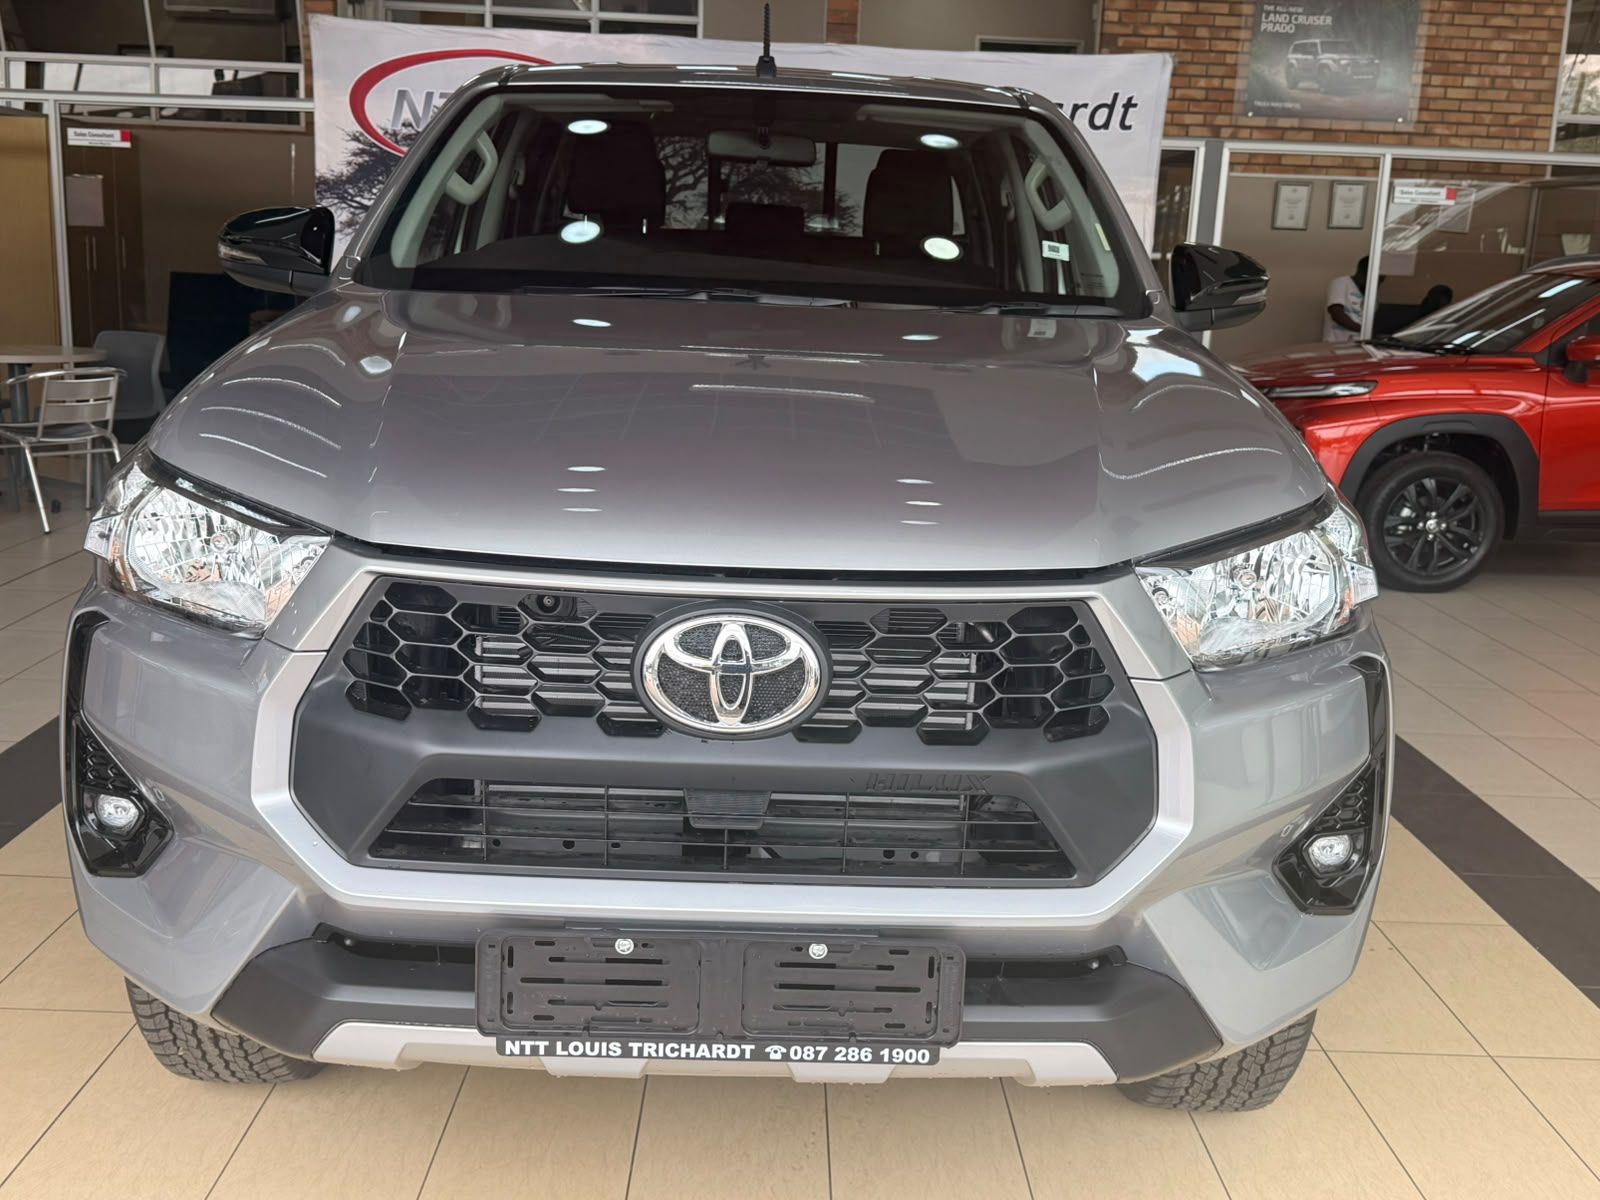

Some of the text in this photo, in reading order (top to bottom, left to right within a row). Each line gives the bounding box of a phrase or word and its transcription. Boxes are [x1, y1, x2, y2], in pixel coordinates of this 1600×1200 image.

[1261, 13, 1333, 25] LAND CRUISER
[1260, 23, 1296, 33] PRADO
[865, 772, 992, 793] HILUX
[505, 1040, 930, 1064] NTT LOUIS TRICHARDT 087 286 1900
